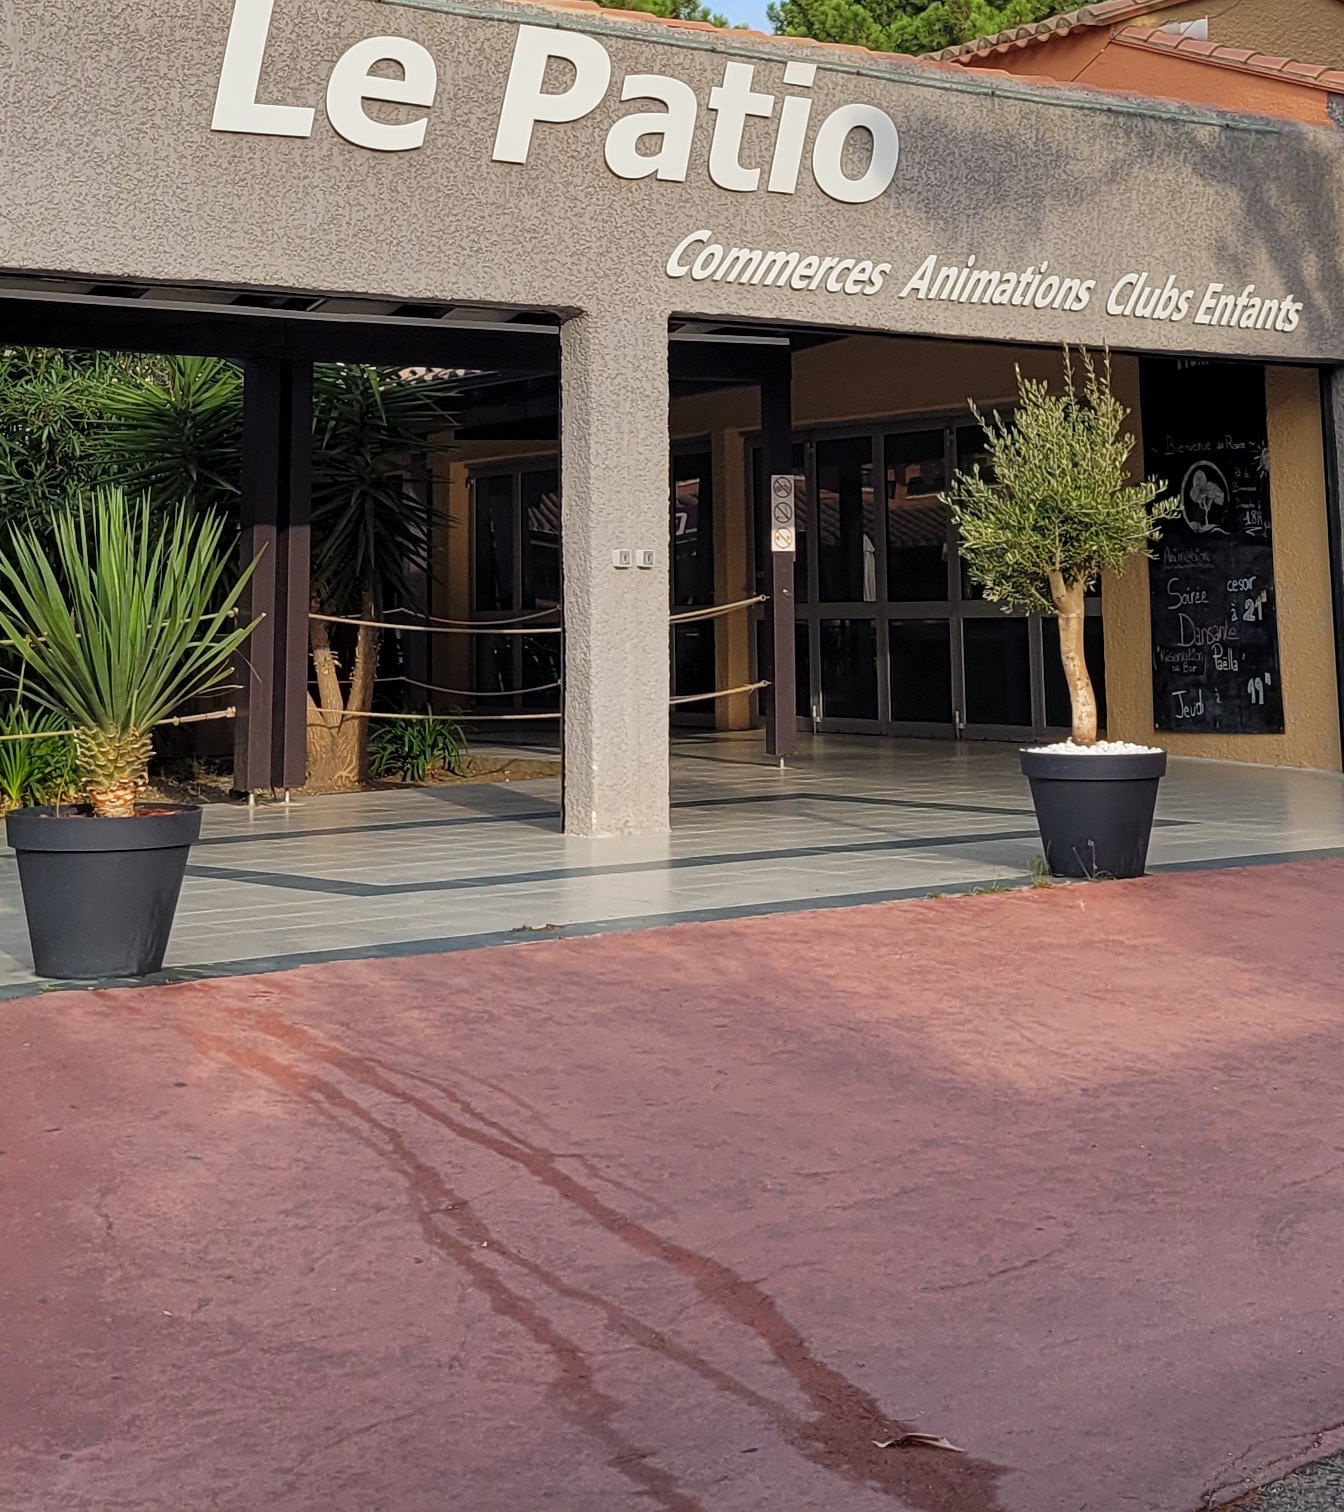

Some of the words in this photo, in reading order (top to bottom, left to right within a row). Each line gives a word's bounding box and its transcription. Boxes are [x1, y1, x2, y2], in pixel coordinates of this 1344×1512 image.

[491, 24, 899, 203] Patio
[665, 229, 892, 295] Commerces
[899, 253, 1097, 312] Animations
[1105, 272, 1195, 322] Clubs
[1193, 282, 1304, 333] Enfants
[1167, 577, 1210, 609] Soirée
[1177, 613, 1241, 647] Dansante
